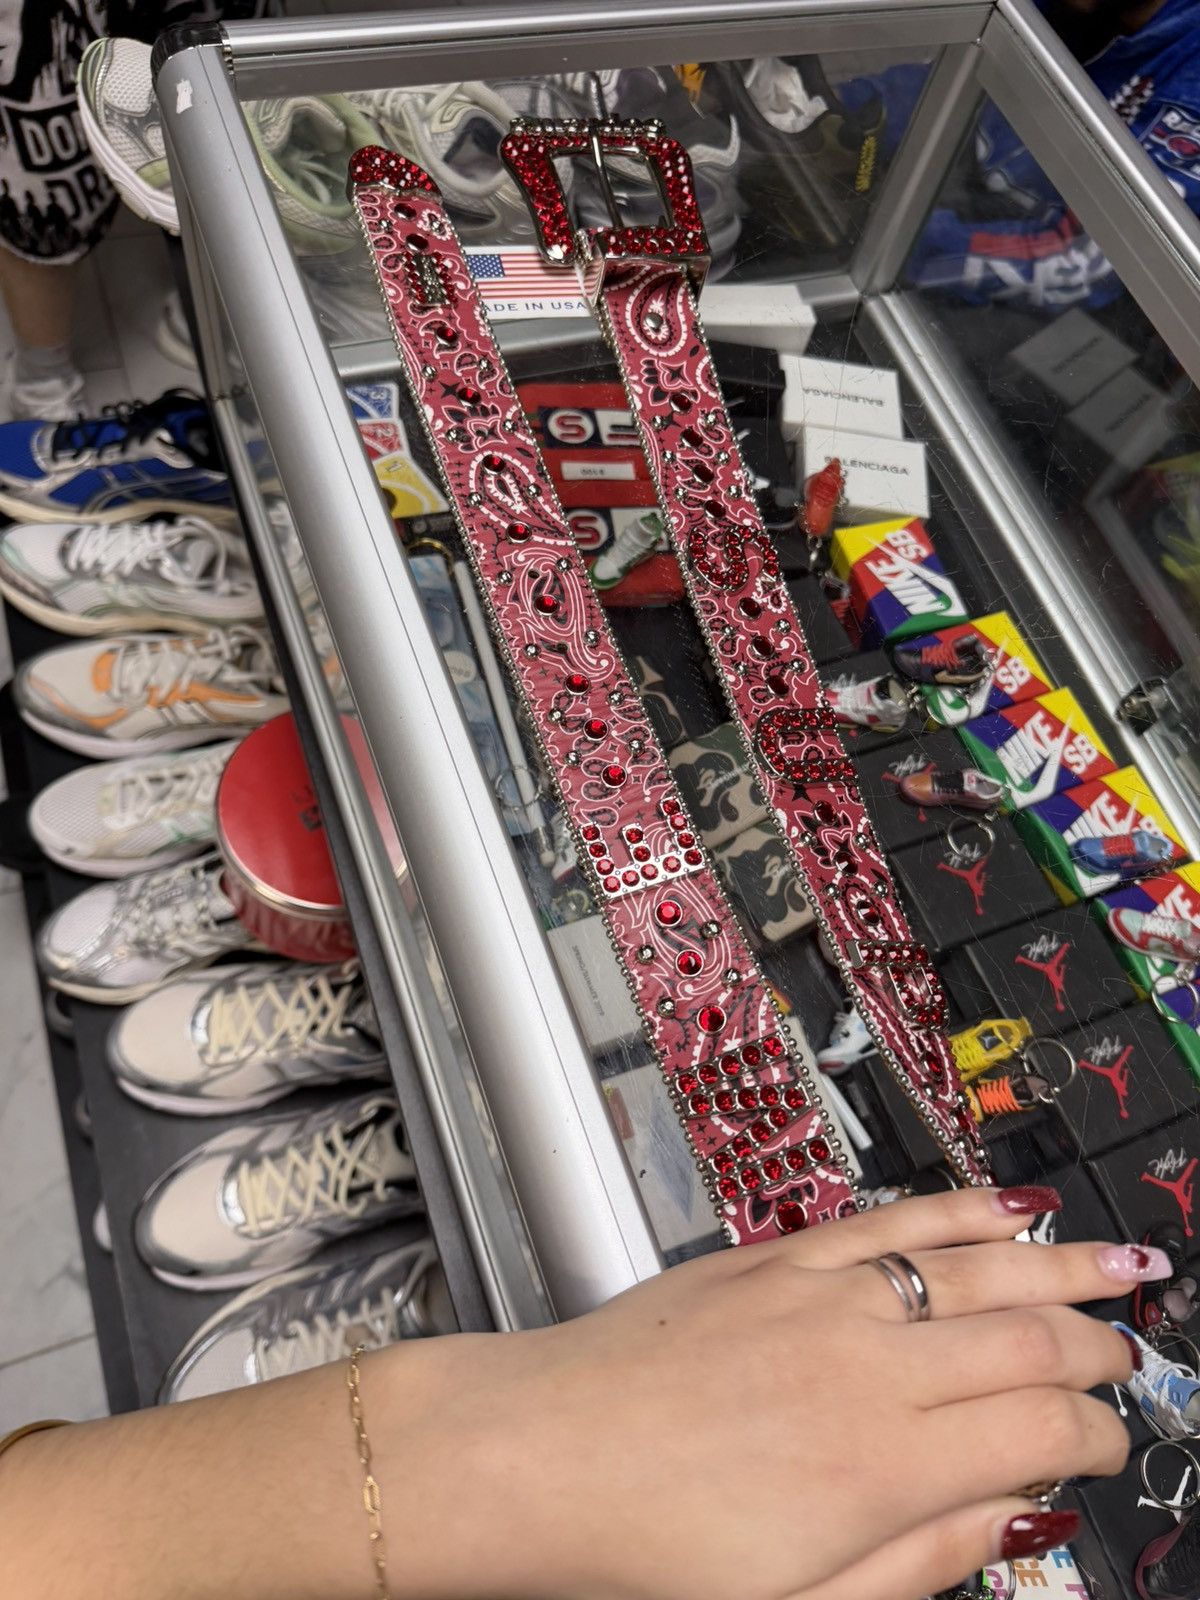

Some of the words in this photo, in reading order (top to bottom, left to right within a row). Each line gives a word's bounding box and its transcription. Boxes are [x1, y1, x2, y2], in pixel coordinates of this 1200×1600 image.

[483, 303, 518, 313] ADE
[525, 302, 544, 311] IN
[551, 301, 588, 311] USA
[802, 387, 884, 408] BALENCIAGA
[824, 456, 909, 475] BLENCIAGA
[886, 529, 929, 562] SB
[864, 559, 947, 616] NIKE
[996, 656, 1031, 694] SB
[996, 710, 1055, 788] NIKE
[1063, 733, 1099, 775] SB
